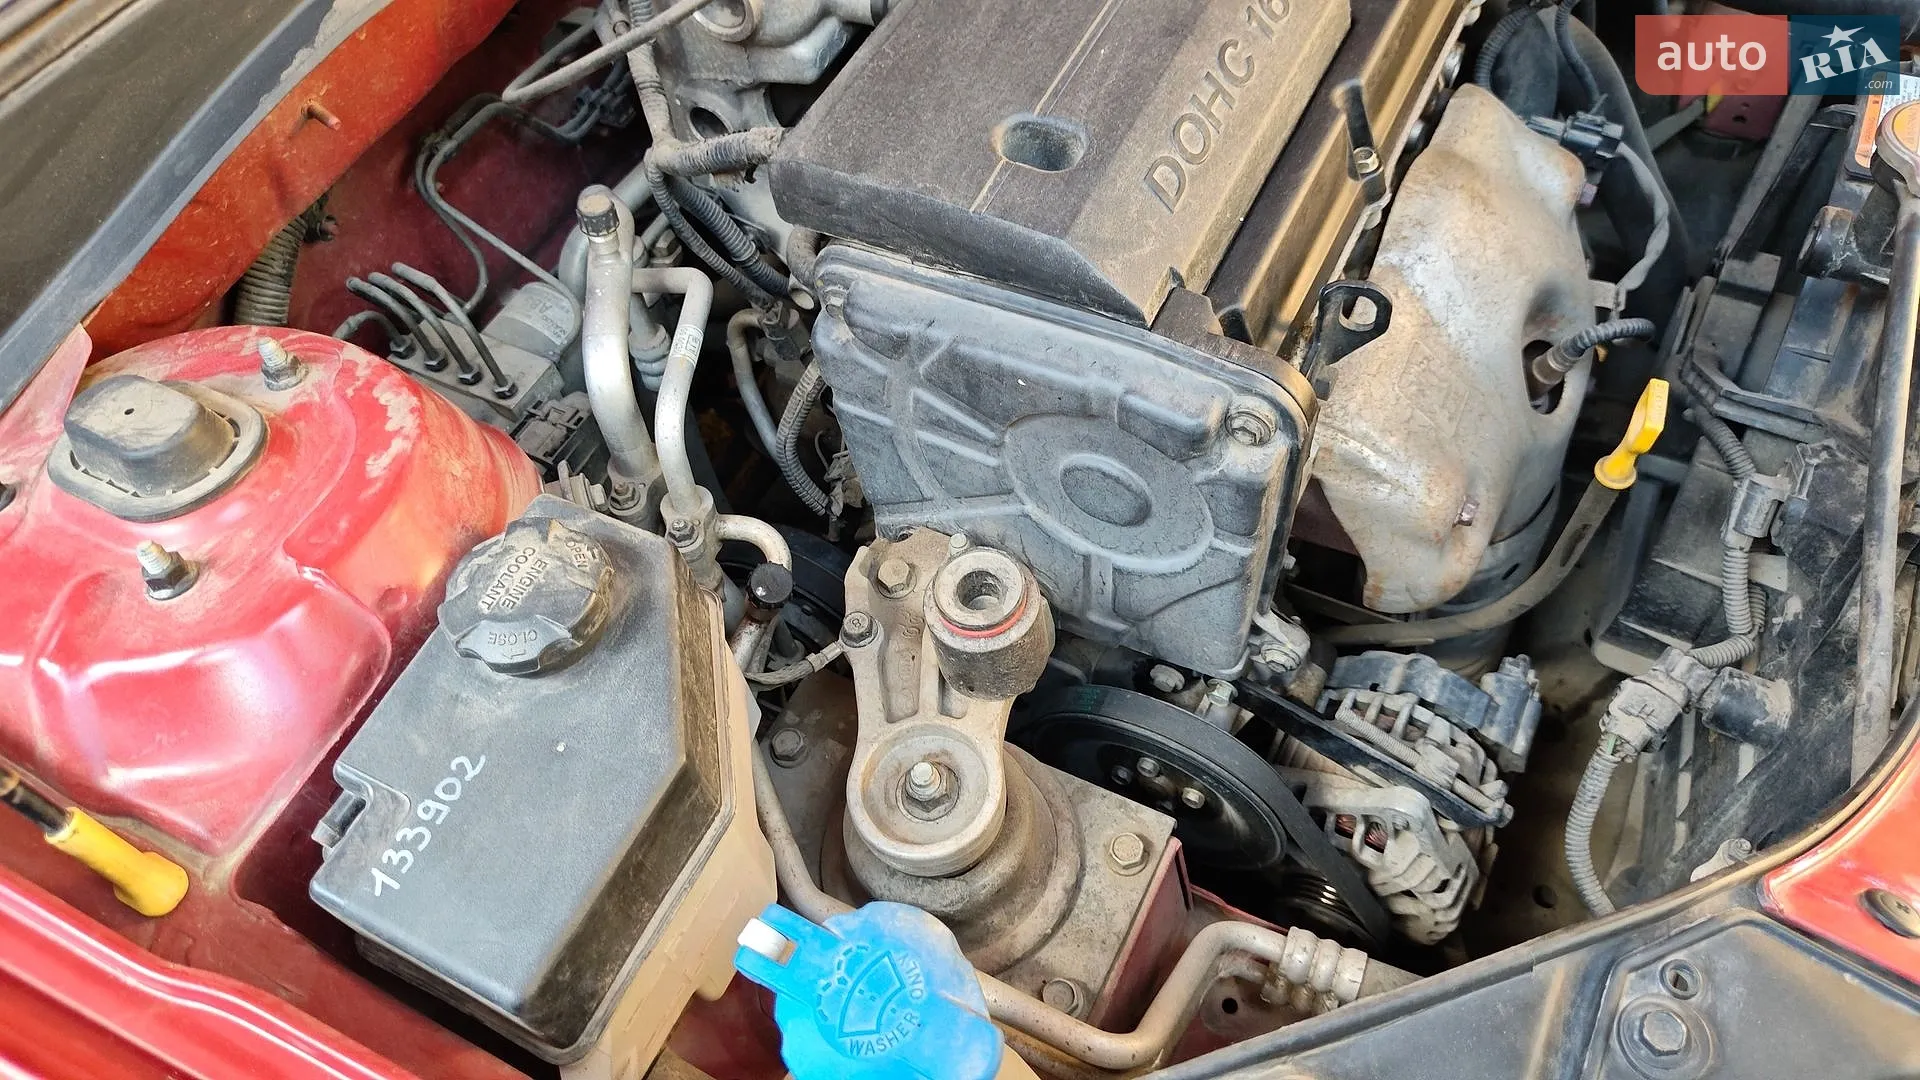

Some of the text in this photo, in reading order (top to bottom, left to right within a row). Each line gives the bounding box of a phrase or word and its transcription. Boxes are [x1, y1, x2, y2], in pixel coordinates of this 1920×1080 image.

[1143, 38, 1255, 214] DOHC
[480, 546, 536, 609] COOLANT
[564, 536, 588, 568] OPEN
[502, 559, 548, 610] ENGINE
[487, 629, 538, 646] CLOSE
[371, 754, 487, 897] 133902
[848, 952, 924, 1056] WASHER ONLY
